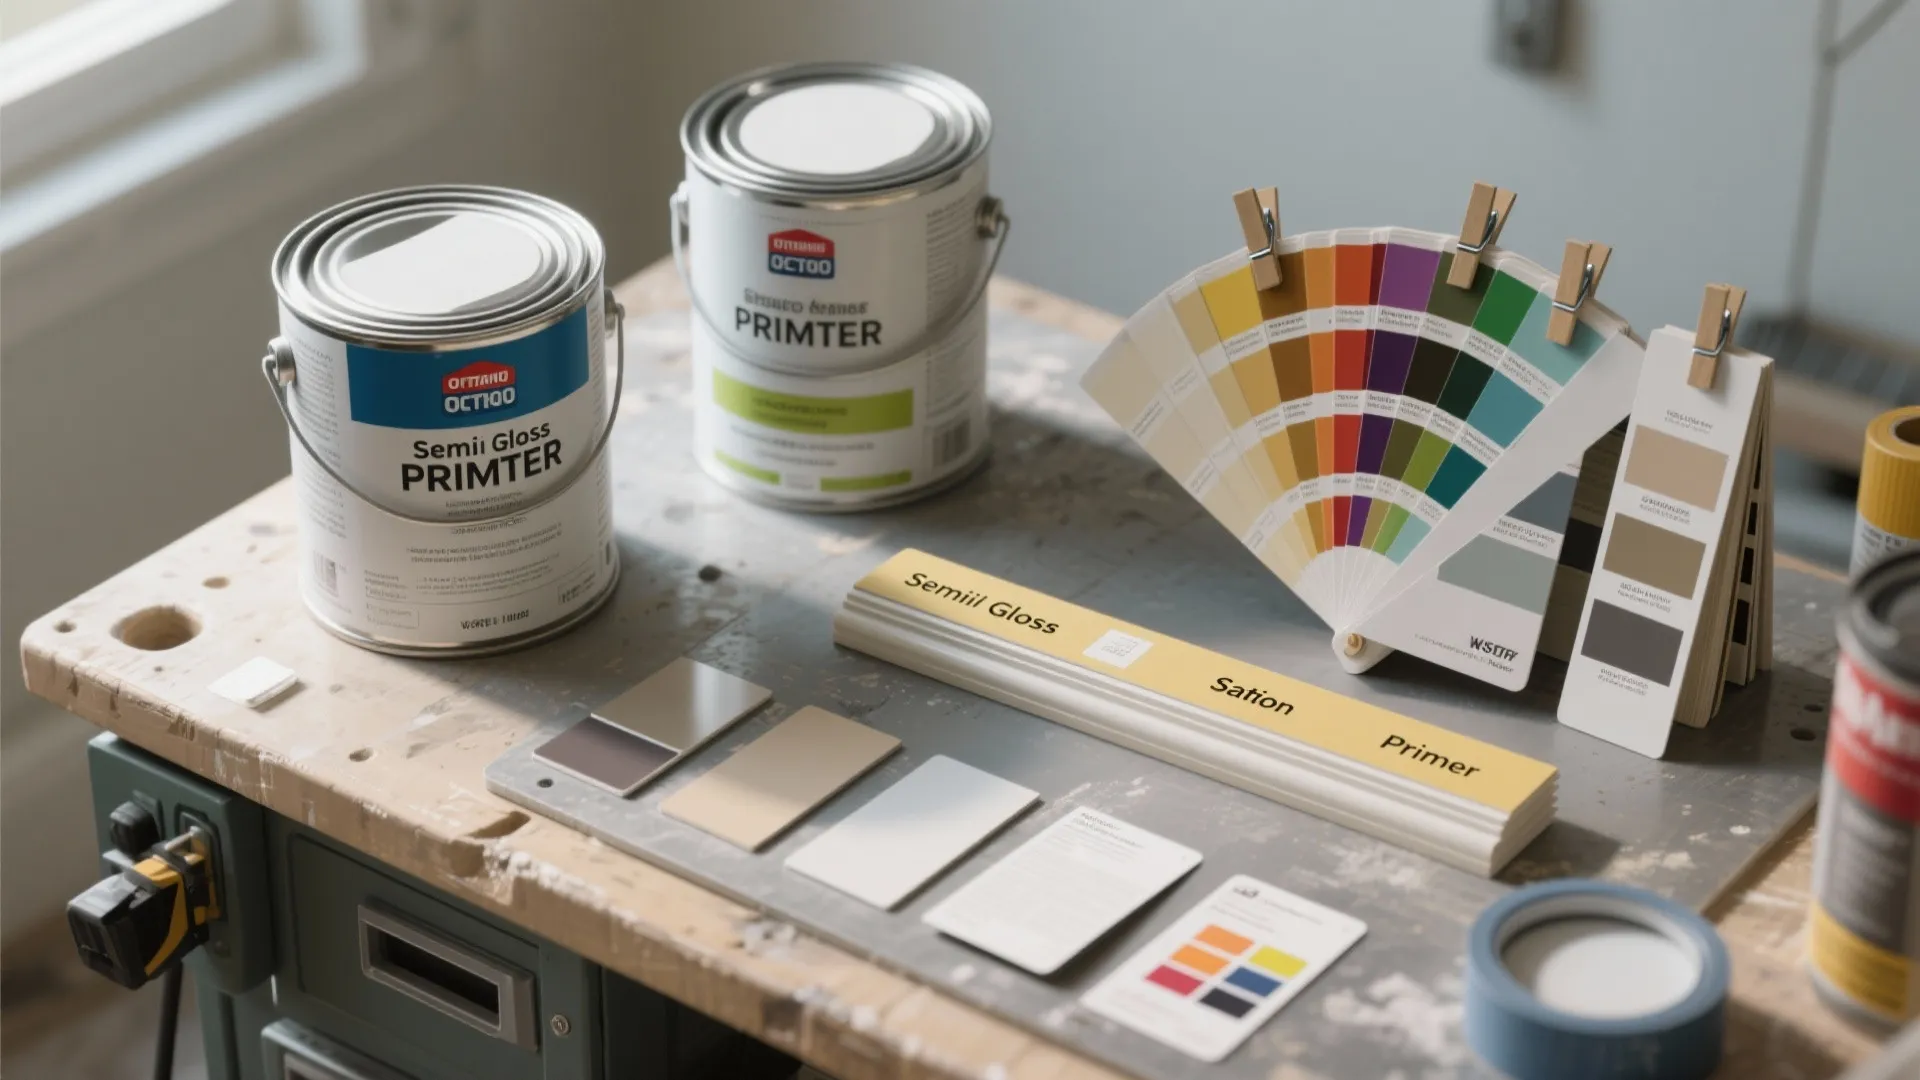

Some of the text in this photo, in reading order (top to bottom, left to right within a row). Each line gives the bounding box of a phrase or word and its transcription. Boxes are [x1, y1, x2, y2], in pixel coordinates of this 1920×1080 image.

[735, 306, 882, 347] PRIMTER
[492, 422, 551, 452] Gloss
[401, 438, 562, 492] PRIMTER
[988, 601, 1059, 634] Gloss
[1210, 677, 1294, 715] Sation
[1380, 734, 1480, 777] Primer
